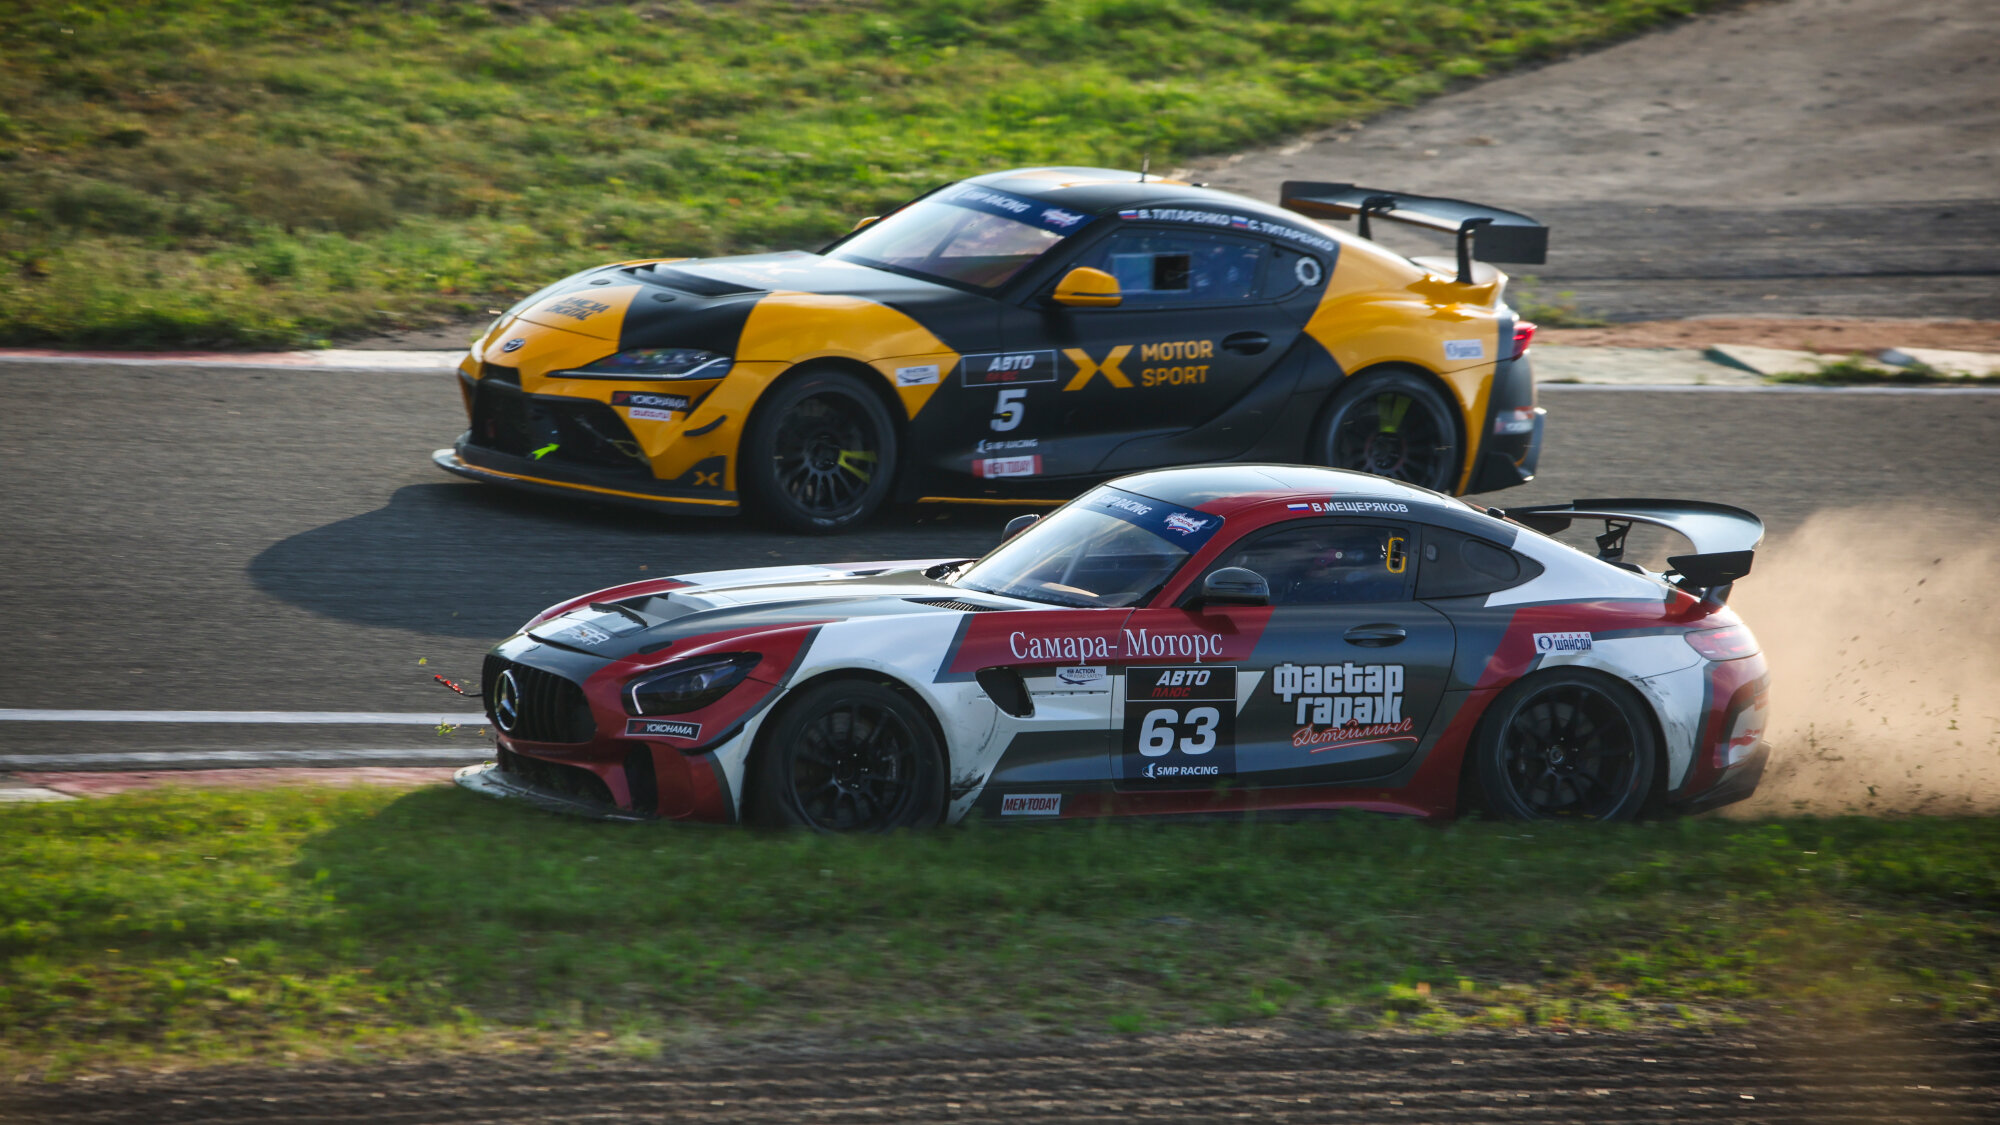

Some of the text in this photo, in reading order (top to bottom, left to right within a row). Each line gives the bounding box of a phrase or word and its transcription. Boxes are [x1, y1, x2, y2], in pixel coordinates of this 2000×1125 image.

[1141, 340, 1214, 362] MOTOR
[987, 355, 1035, 372] АВТО
[1142, 365, 1210, 387] SPORT
[990, 388, 1027, 431] 5
[1311, 502, 1409, 513] В.МЕЩЕРЯКОВ
[1124, 628, 1223, 663] Моторс
[1156, 670, 1211, 686] АВТО
[1152, 687, 1191, 697] ПЛЮС
[646, 723, 692, 735] YOKOHAMA
[1138, 707, 1220, 757] 63
[1156, 766, 1219, 776] SMP RACING
